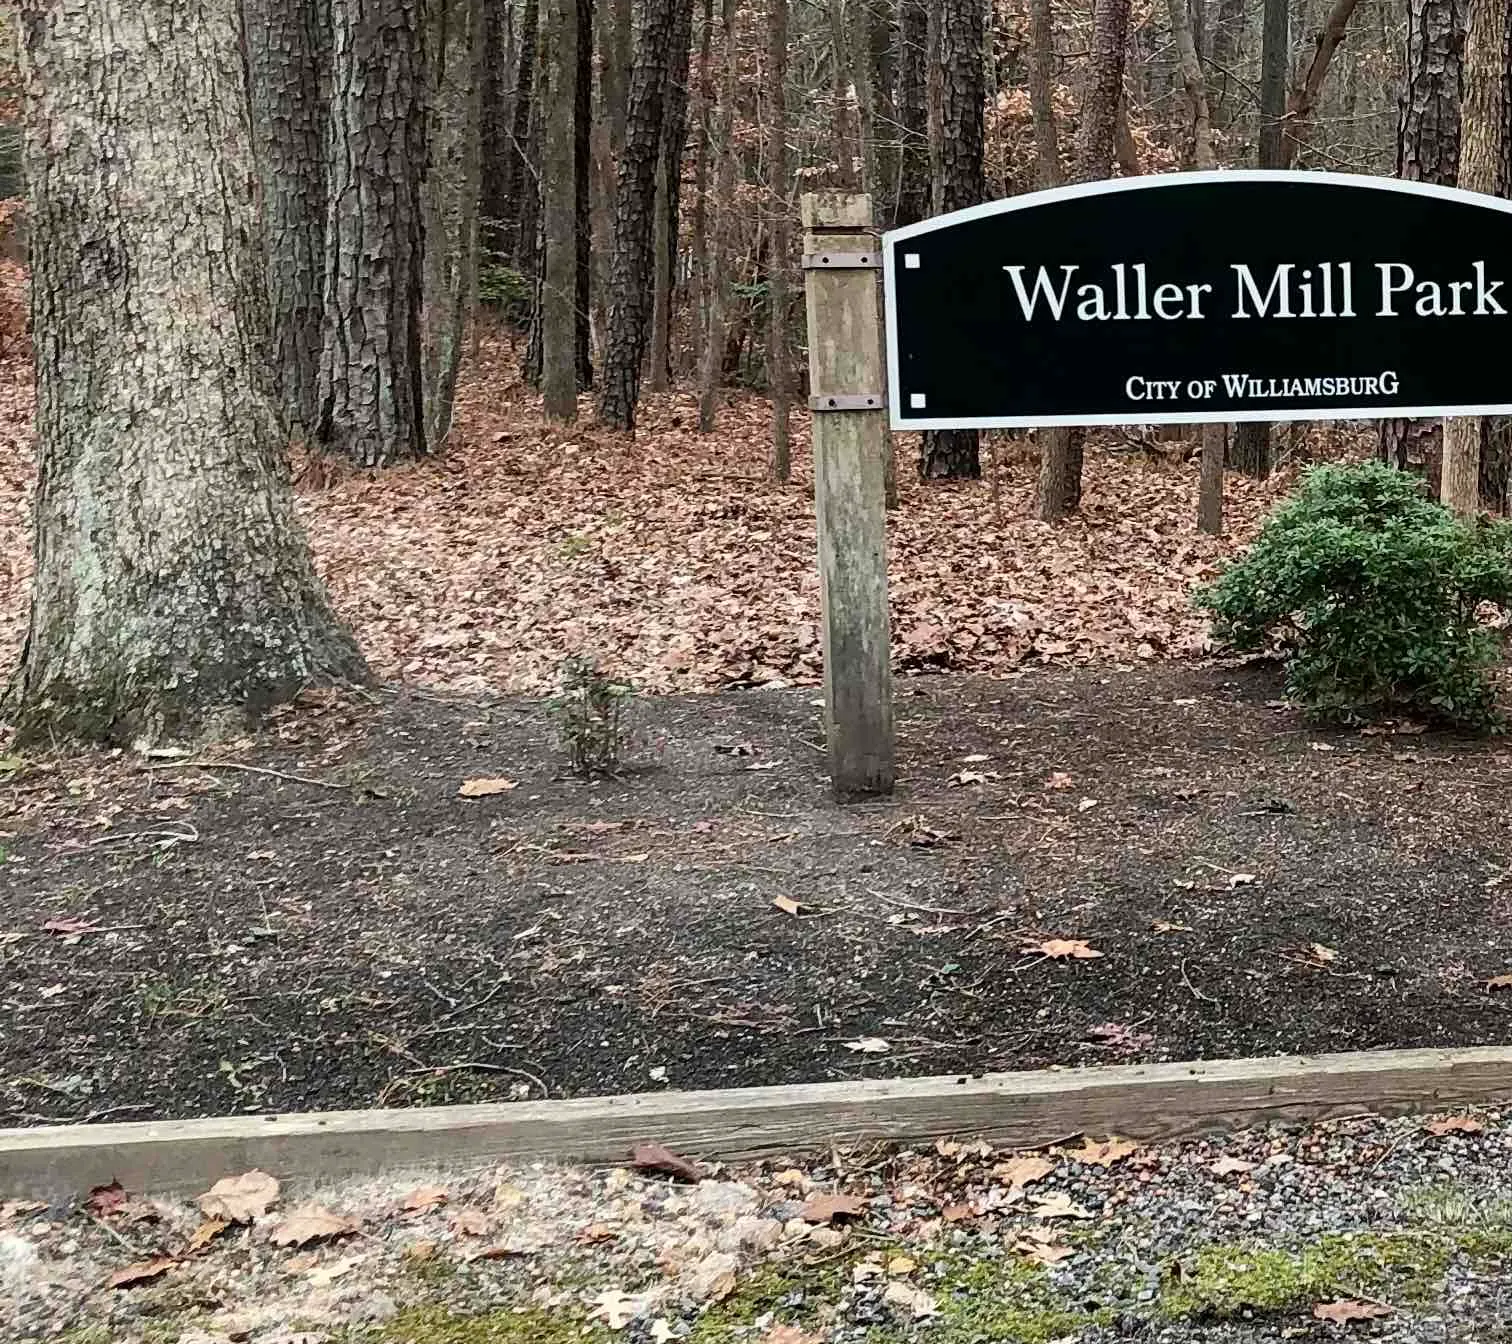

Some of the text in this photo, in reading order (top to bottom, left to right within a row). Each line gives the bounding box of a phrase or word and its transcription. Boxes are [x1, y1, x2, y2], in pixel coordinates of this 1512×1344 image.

[1002, 260, 1509, 322] Waller Mill Park
